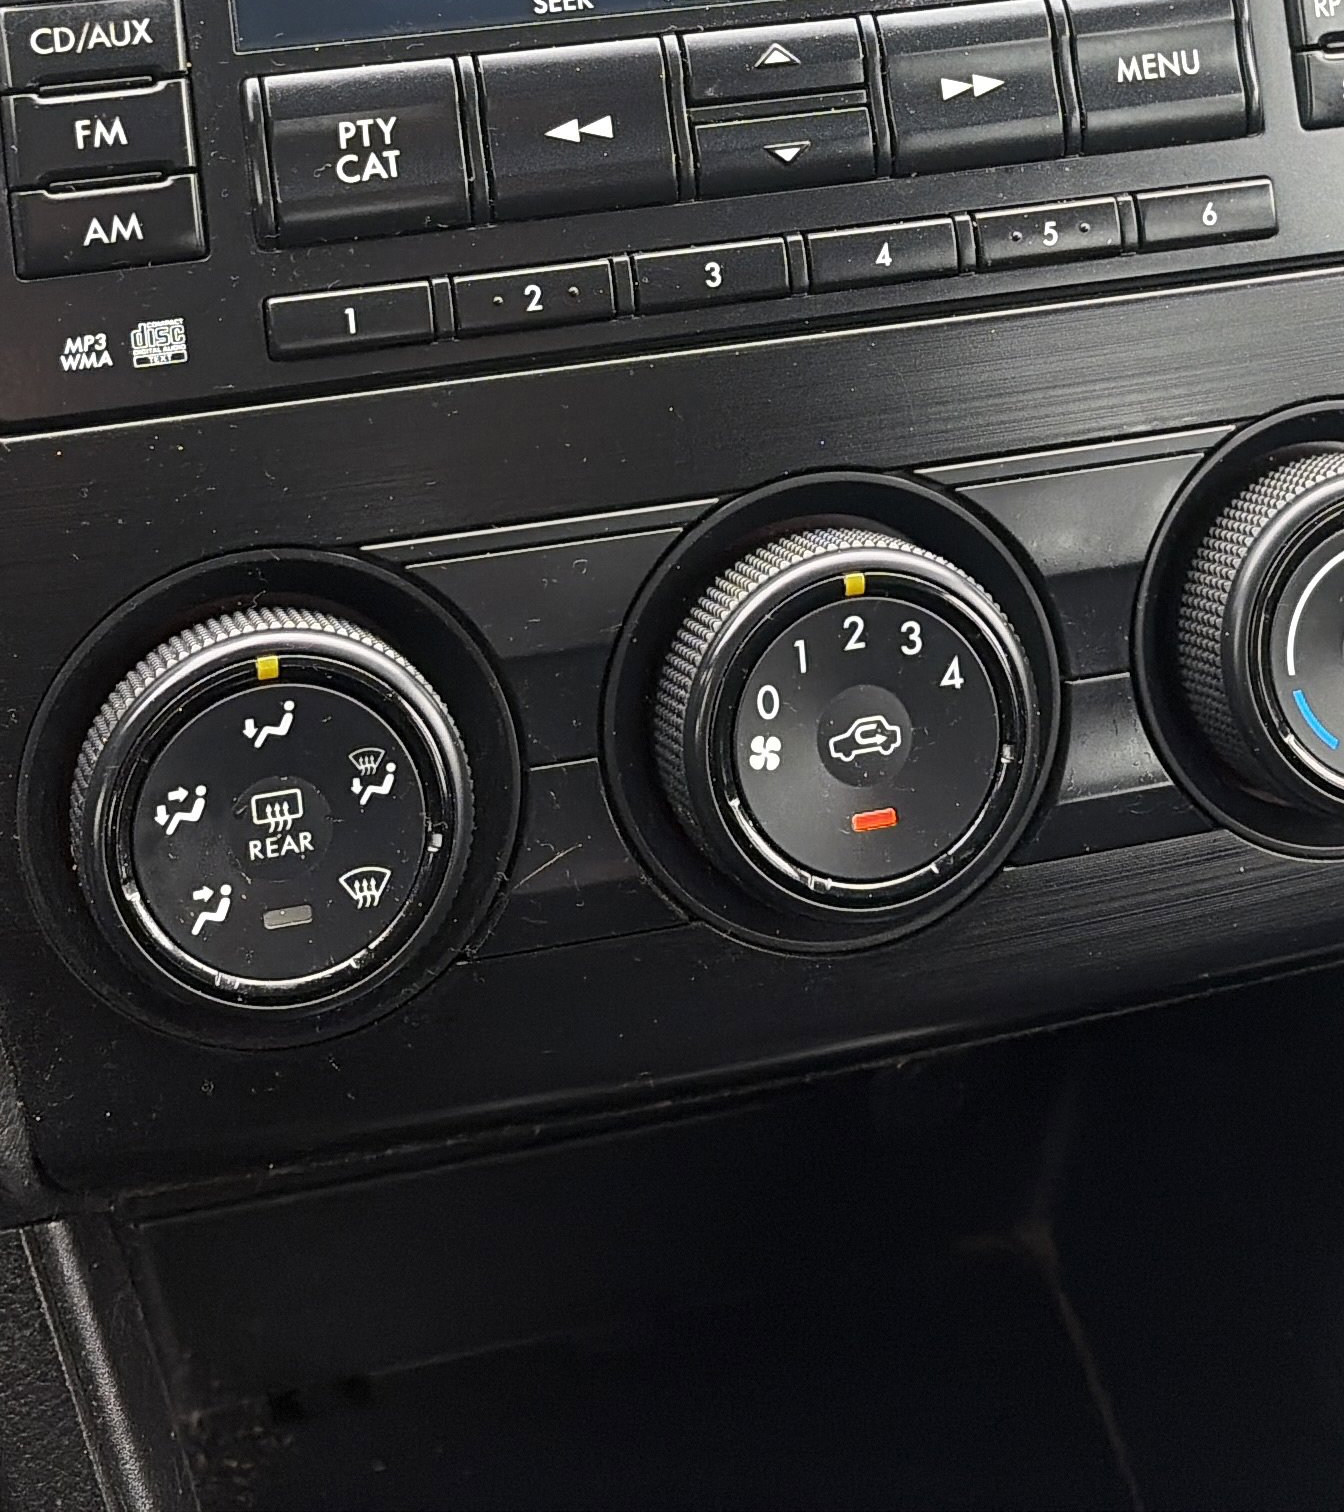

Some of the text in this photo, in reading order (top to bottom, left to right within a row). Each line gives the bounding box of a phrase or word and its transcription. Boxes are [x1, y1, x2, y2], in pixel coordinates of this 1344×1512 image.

[29, 17, 153, 55] CD/AUX
[1117, 48, 1201, 83] MENU
[74, 116, 128, 150] FM
[338, 116, 397, 150] PTY
[335, 150, 401, 185] CAT
[83, 212, 144, 246] AM
[1202, 201, 1218, 226] 6
[1042, 221, 1059, 247] 5
[875, 241, 893, 267] 4
[704, 261, 722, 288] 3
[524, 285, 544, 312] 2
[343, 307, 358, 336] 1
[64, 332, 108, 355] MP3
[59, 350, 114, 372] WMA
[843, 615, 866, 651] 2
[900, 620, 923, 656] 3
[793, 639, 807, 674] 1
[939, 655, 965, 689] 4
[756, 684, 780, 720] 0
[248, 827, 315, 861] REAR
